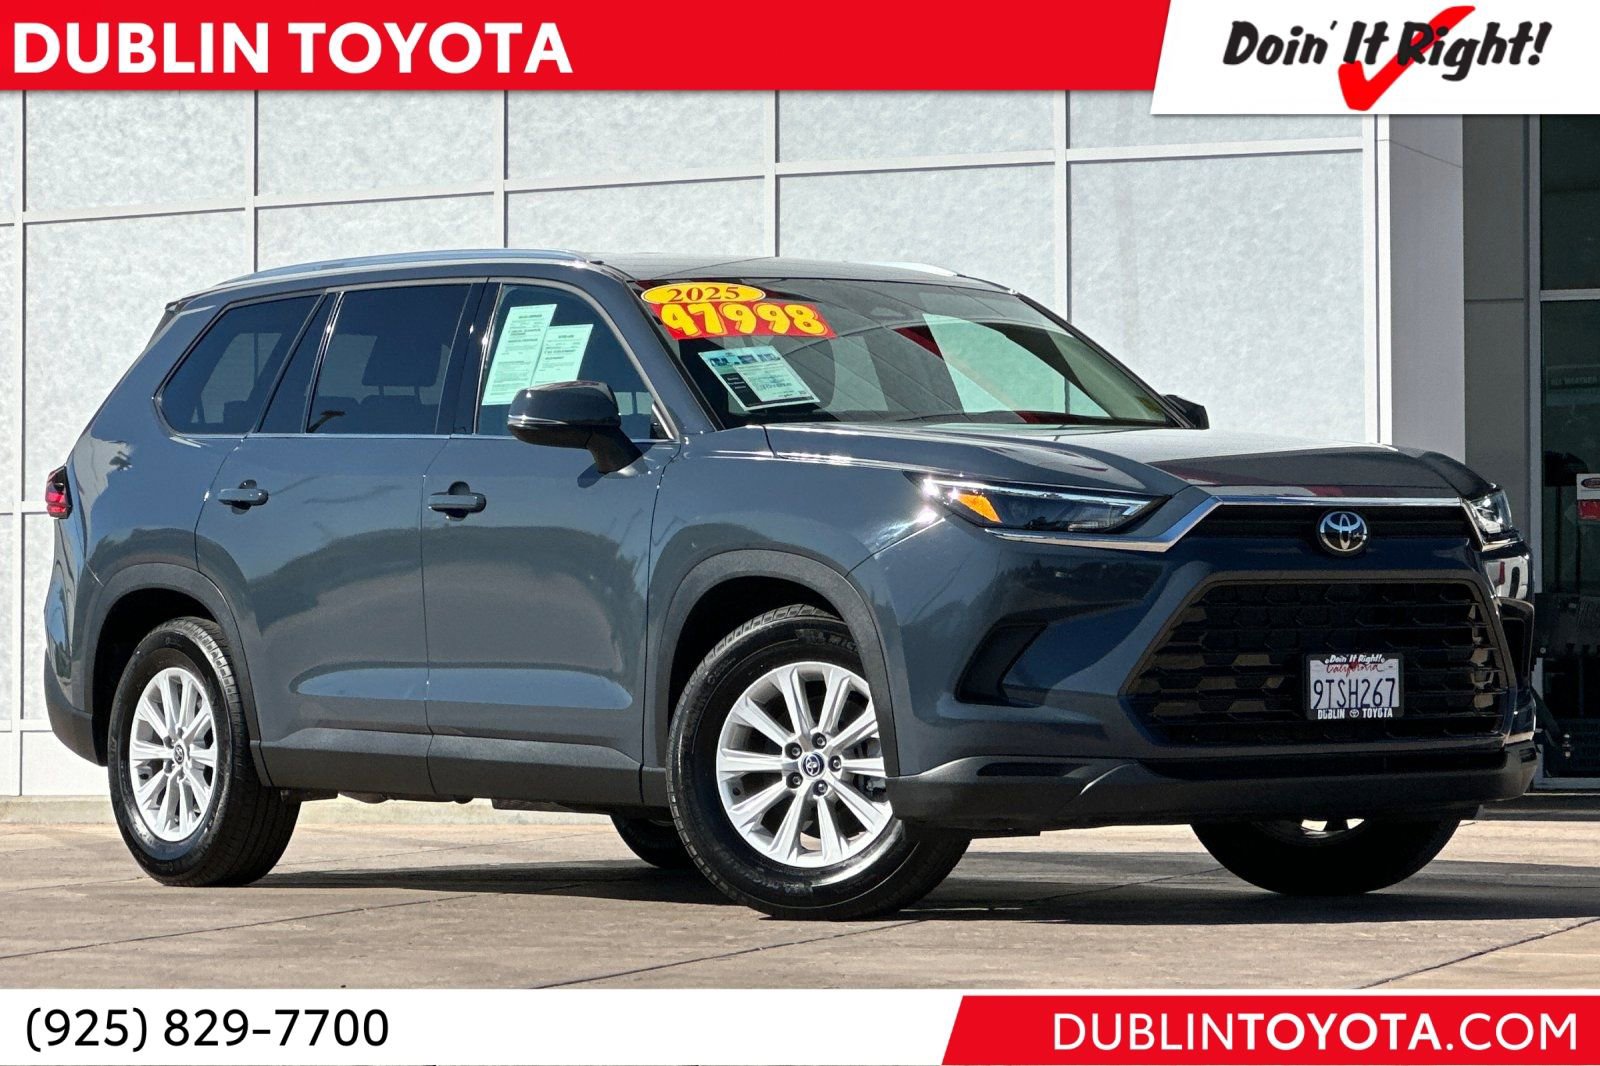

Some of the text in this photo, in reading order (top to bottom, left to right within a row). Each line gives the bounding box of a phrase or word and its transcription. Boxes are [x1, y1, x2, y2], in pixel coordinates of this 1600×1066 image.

[666, 286, 740, 303] 2025
[660, 302, 827, 337] 47998
[1326, 661, 1384, 677] Califrnia
[1313, 677, 1395, 709] 9TSH267
[1317, 707, 1393, 719] DUBLIN TOYOTA
